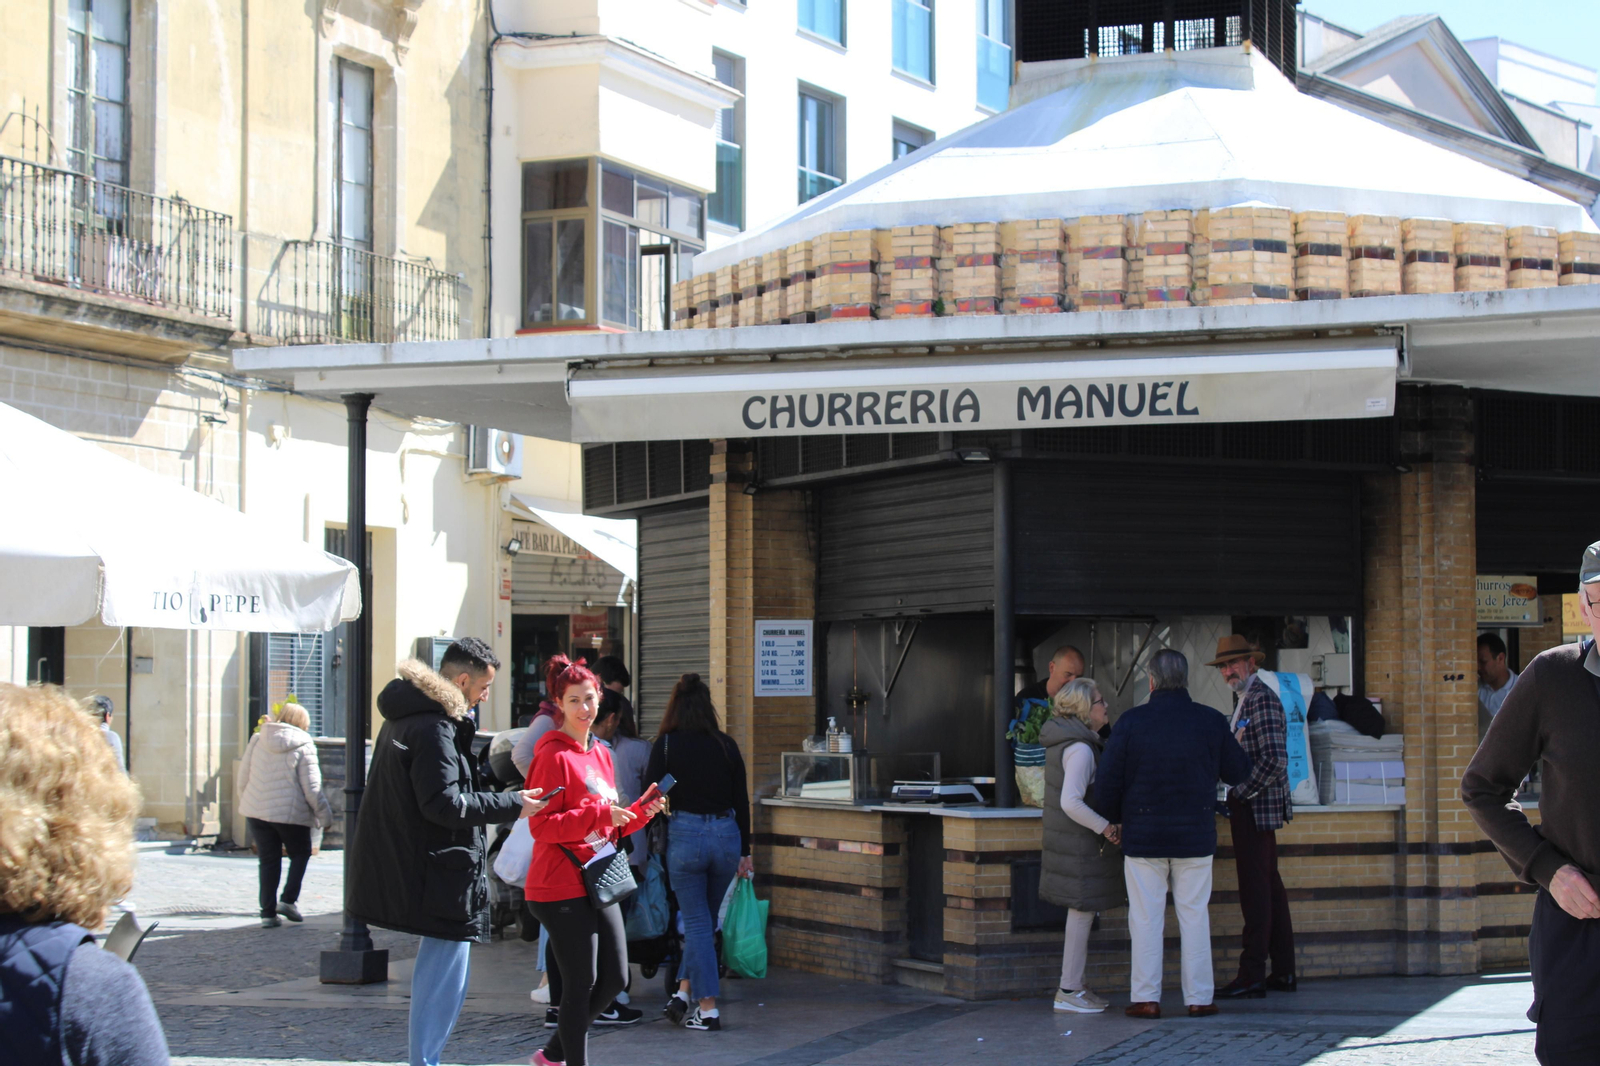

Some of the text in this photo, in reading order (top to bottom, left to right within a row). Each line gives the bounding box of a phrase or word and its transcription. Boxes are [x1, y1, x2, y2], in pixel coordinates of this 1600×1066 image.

[742, 381, 1199, 431] CHURRERIA MANUEL
[532, 532, 549, 552] BAR
[551, 535, 561, 553] LA
[1476, 579, 1511, 590] hurros
[153, 591, 261, 613] TIO PEPE
[1485, 594, 1497, 606] de
[1502, 594, 1528, 608] Jerez
